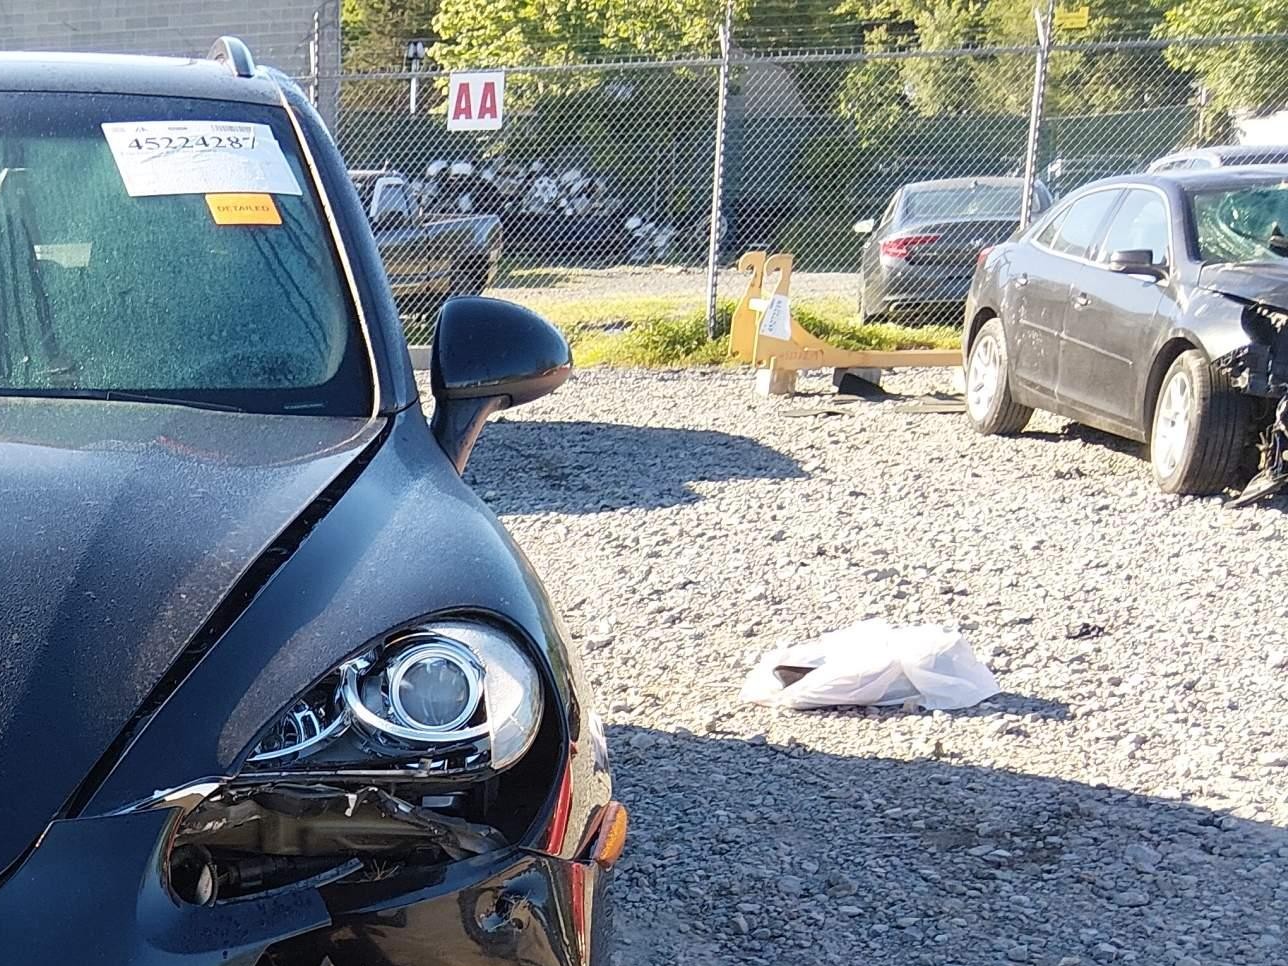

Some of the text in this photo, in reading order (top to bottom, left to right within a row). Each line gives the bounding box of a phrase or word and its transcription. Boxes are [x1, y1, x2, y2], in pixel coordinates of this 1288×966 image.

[452, 81, 498, 121] AA
[128, 135, 256, 150] 45224287
[216, 205, 270, 213] DETAILED
